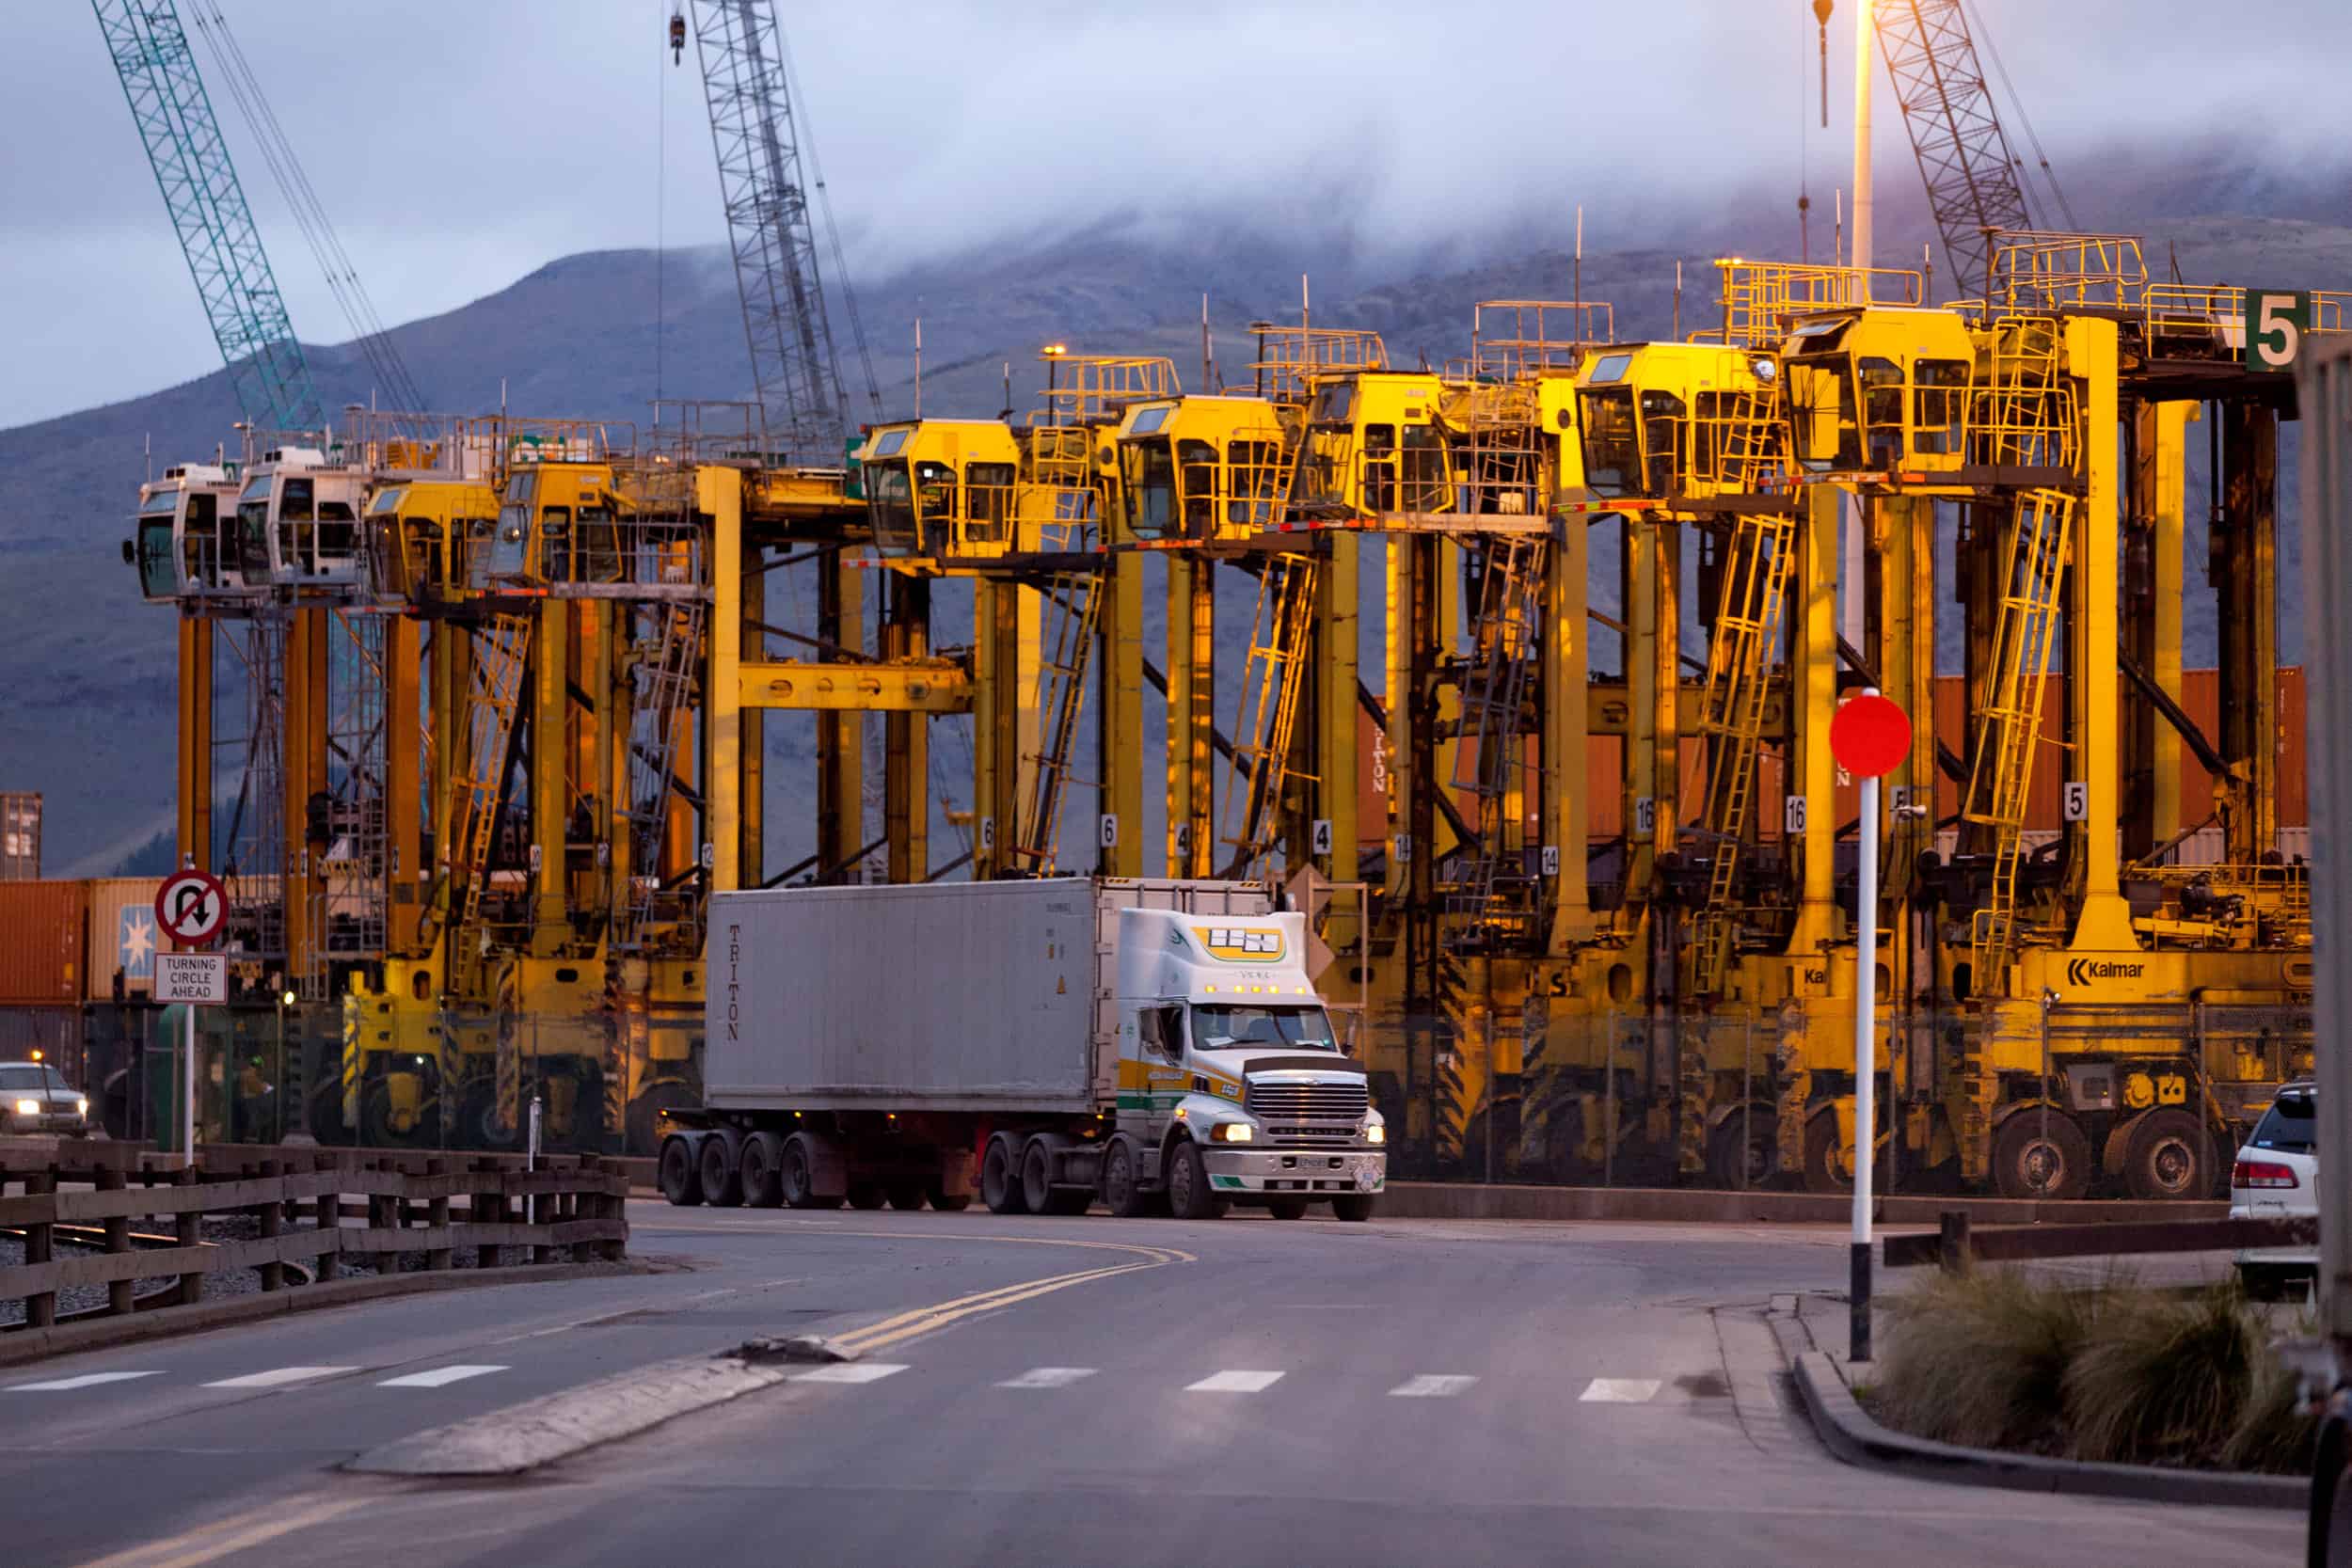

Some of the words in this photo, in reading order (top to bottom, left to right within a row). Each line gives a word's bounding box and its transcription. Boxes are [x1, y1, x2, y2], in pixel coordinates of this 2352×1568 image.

[2257, 294, 2298, 367] 5
[2070, 787, 2082, 816] 5
[1789, 800, 1804, 830] 16
[1104, 818, 1114, 843] 6
[1178, 827, 1187, 850] 4
[1317, 824, 1328, 849] 4
[1544, 849, 1557, 871] 14
[166, 958, 216, 971] TURNING
[2089, 961, 2144, 978] Kalmar
[170, 972, 211, 985] CIRCLE
[729, 925, 739, 1041] TRITON
[171, 986, 211, 998] AHEAD
